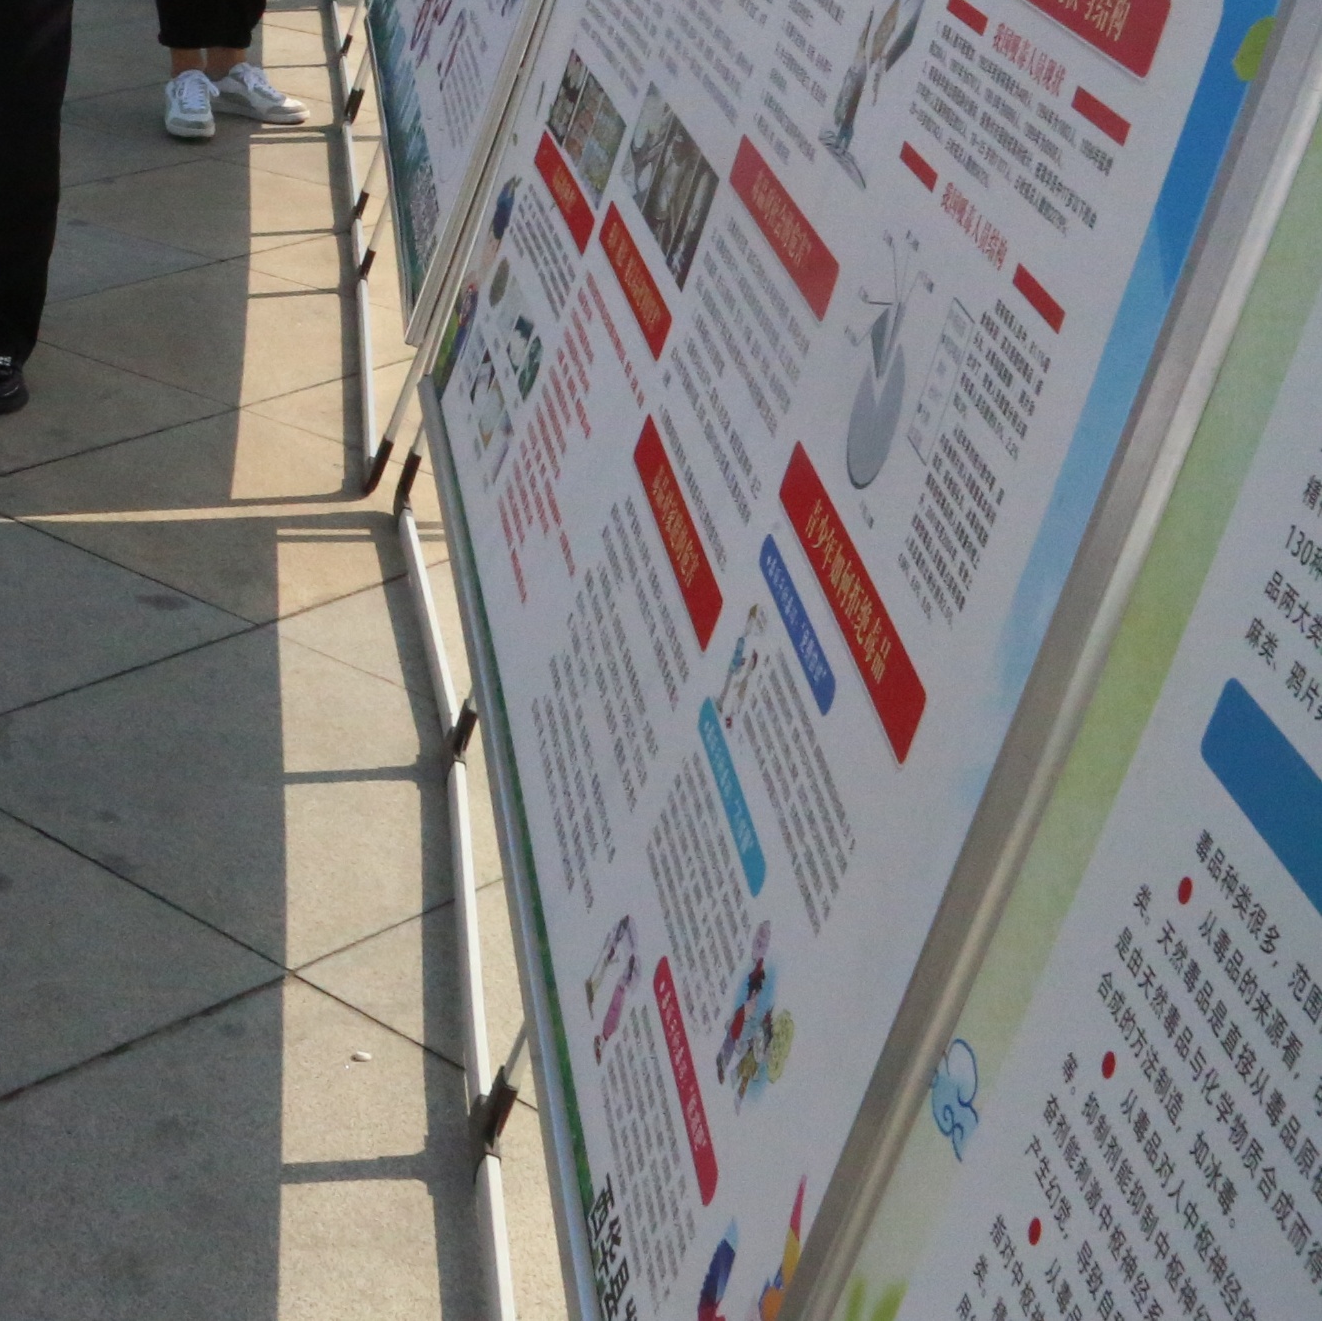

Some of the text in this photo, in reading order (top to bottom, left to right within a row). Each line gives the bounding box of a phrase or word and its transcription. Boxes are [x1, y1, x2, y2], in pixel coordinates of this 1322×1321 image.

[805, 499, 892, 686] 青少年如何拒绝毒品
[1264, 570, 1322, 650] 品两大类
[1245, 617, 1322, 721] 麻类、鸦片
